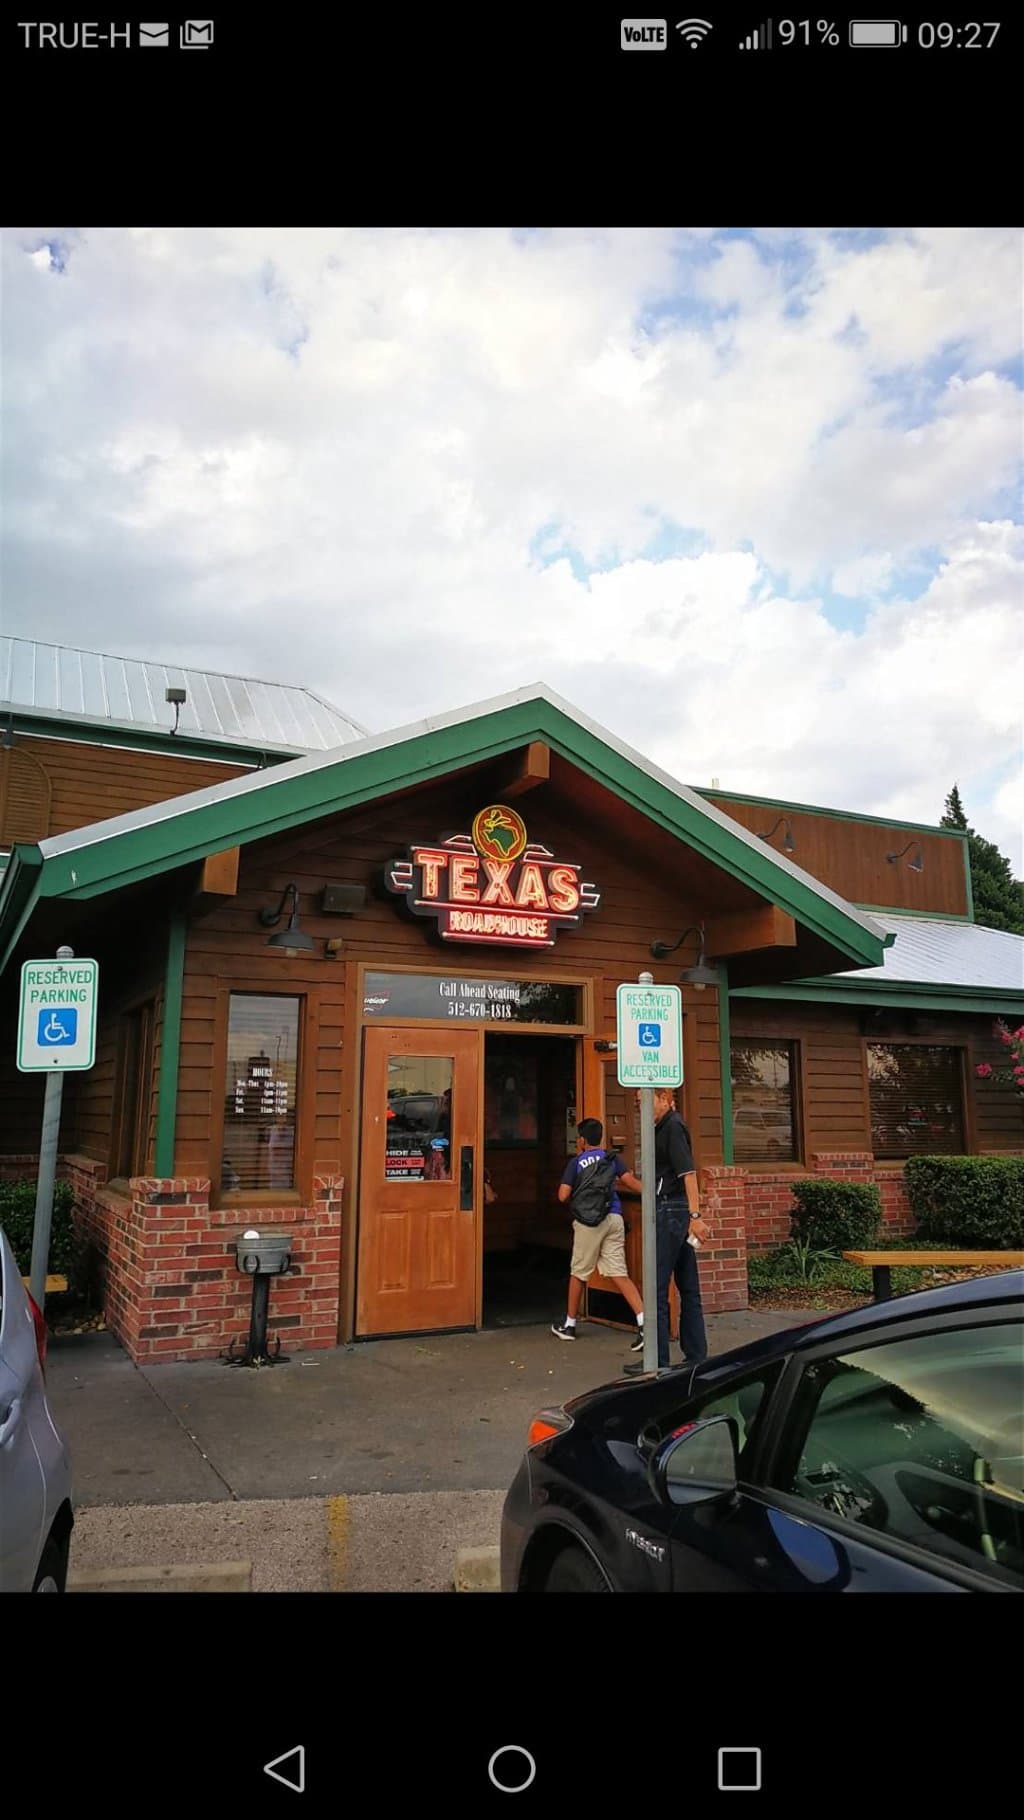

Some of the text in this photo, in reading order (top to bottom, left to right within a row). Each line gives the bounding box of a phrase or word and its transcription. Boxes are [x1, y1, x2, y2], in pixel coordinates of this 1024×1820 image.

[414, 850, 581, 912] TEXAS
[449, 910, 548, 938] ROADHOUSE
[27, 970, 93, 985] RESERVED
[30, 989, 87, 1003] PARKING
[439, 982, 521, 1003] Call Ahead Seating
[626, 993, 672, 1007] RESERVED
[447, 1002, 512, 1018] 512-670-1818
[630, 1007, 669, 1021] PARKING
[641, 1050, 660, 1063] VAN
[623, 1064, 679, 1078] ACCESSIBLE
